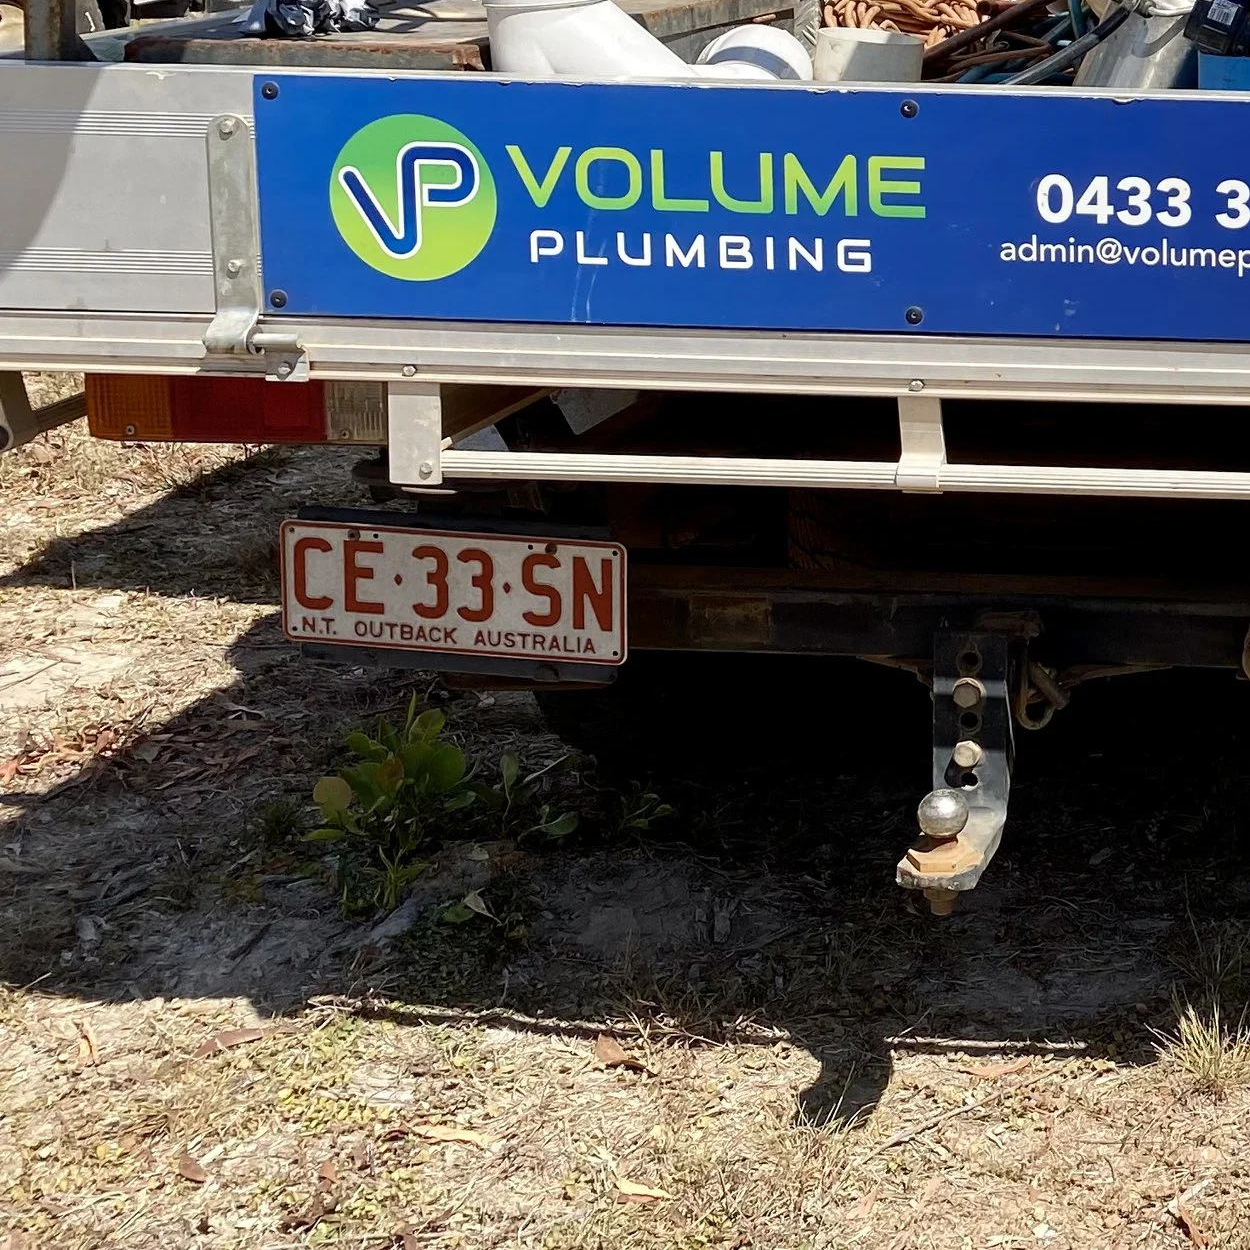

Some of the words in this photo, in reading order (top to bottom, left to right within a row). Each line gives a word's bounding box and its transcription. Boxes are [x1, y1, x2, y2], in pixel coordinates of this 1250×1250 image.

[505, 144, 926, 219] VOLUME
[1036, 174, 1192, 228] 0433
[530, 230, 872, 274] PLUMBING
[302, 616, 337, 635] N.T.
[354, 621, 457, 644] OUTBACK
[473, 630, 596, 655] AUSTRALIA
